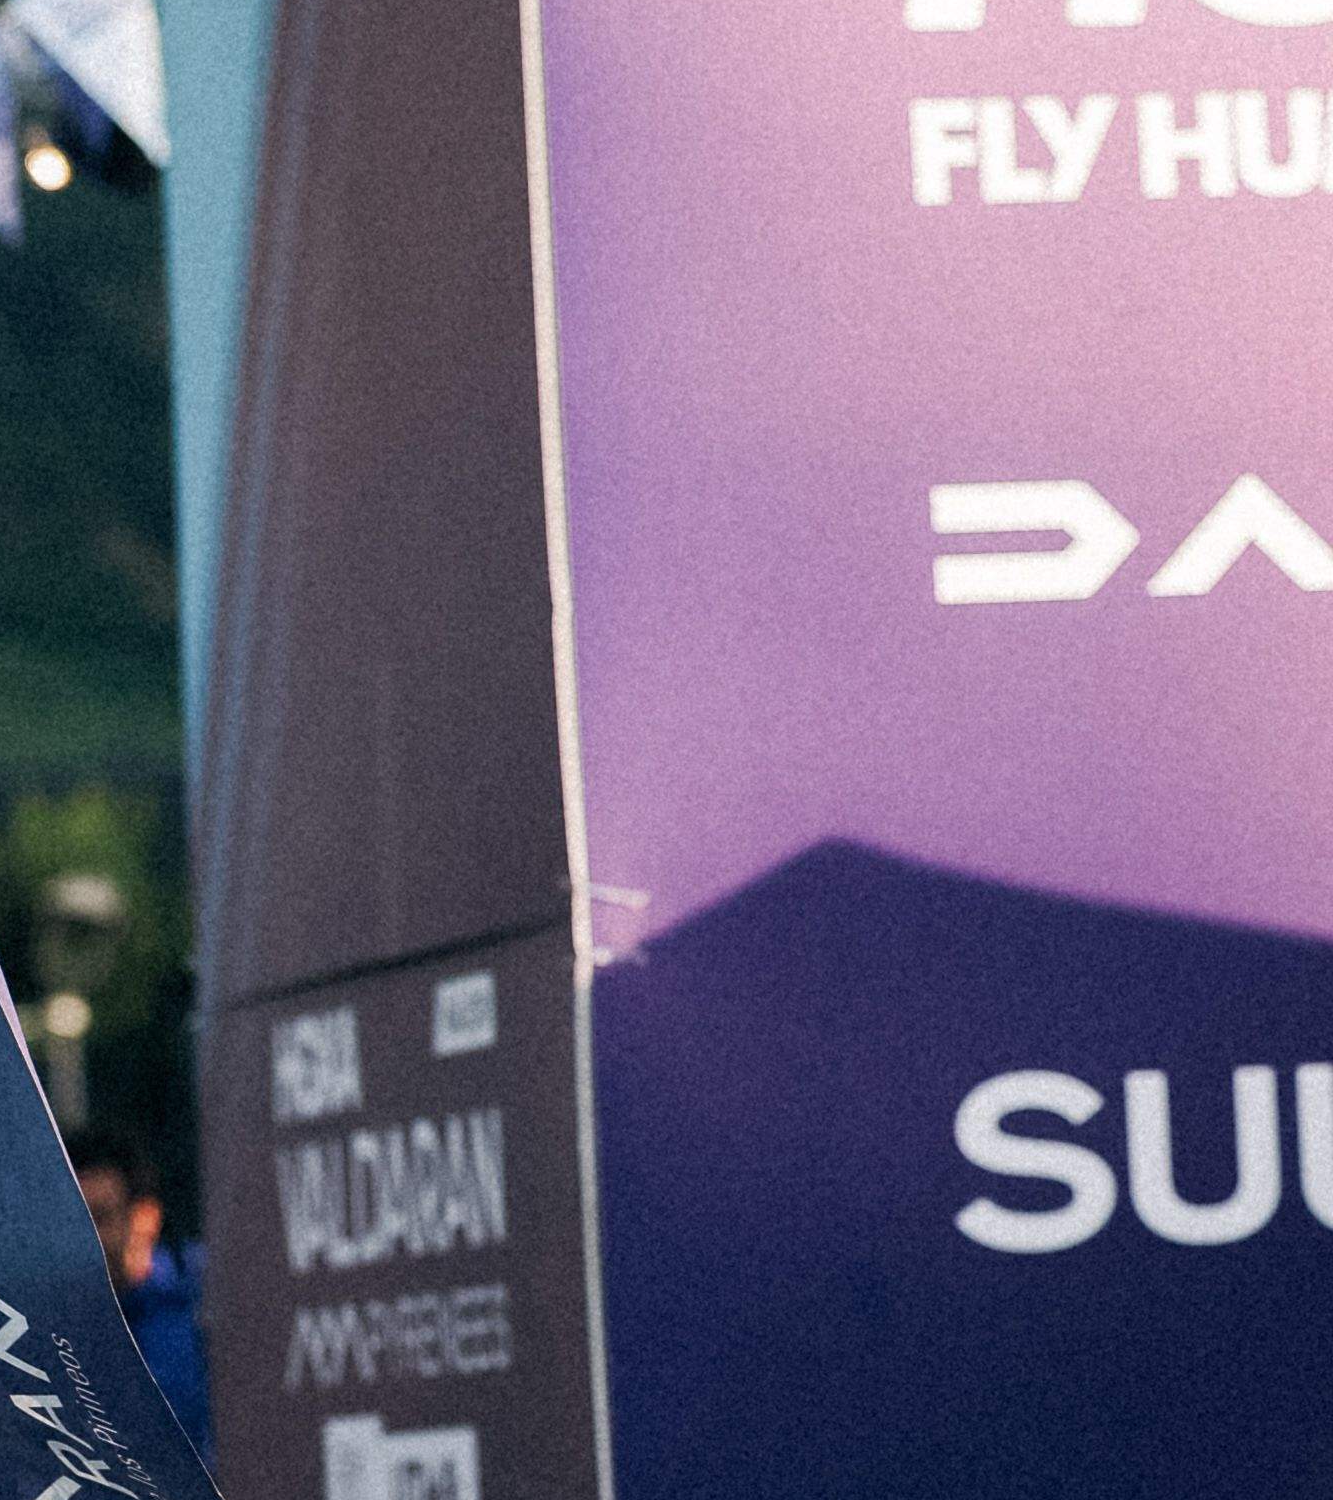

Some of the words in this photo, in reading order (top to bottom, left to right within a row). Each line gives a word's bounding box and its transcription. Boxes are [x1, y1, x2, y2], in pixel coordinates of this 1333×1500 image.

[908, 95, 1117, 206] FLY
[1136, 88, 1333, 201] HU
[954, 1062, 1333, 1254] SU
[51, 1332, 128, 1449] Pirineos
